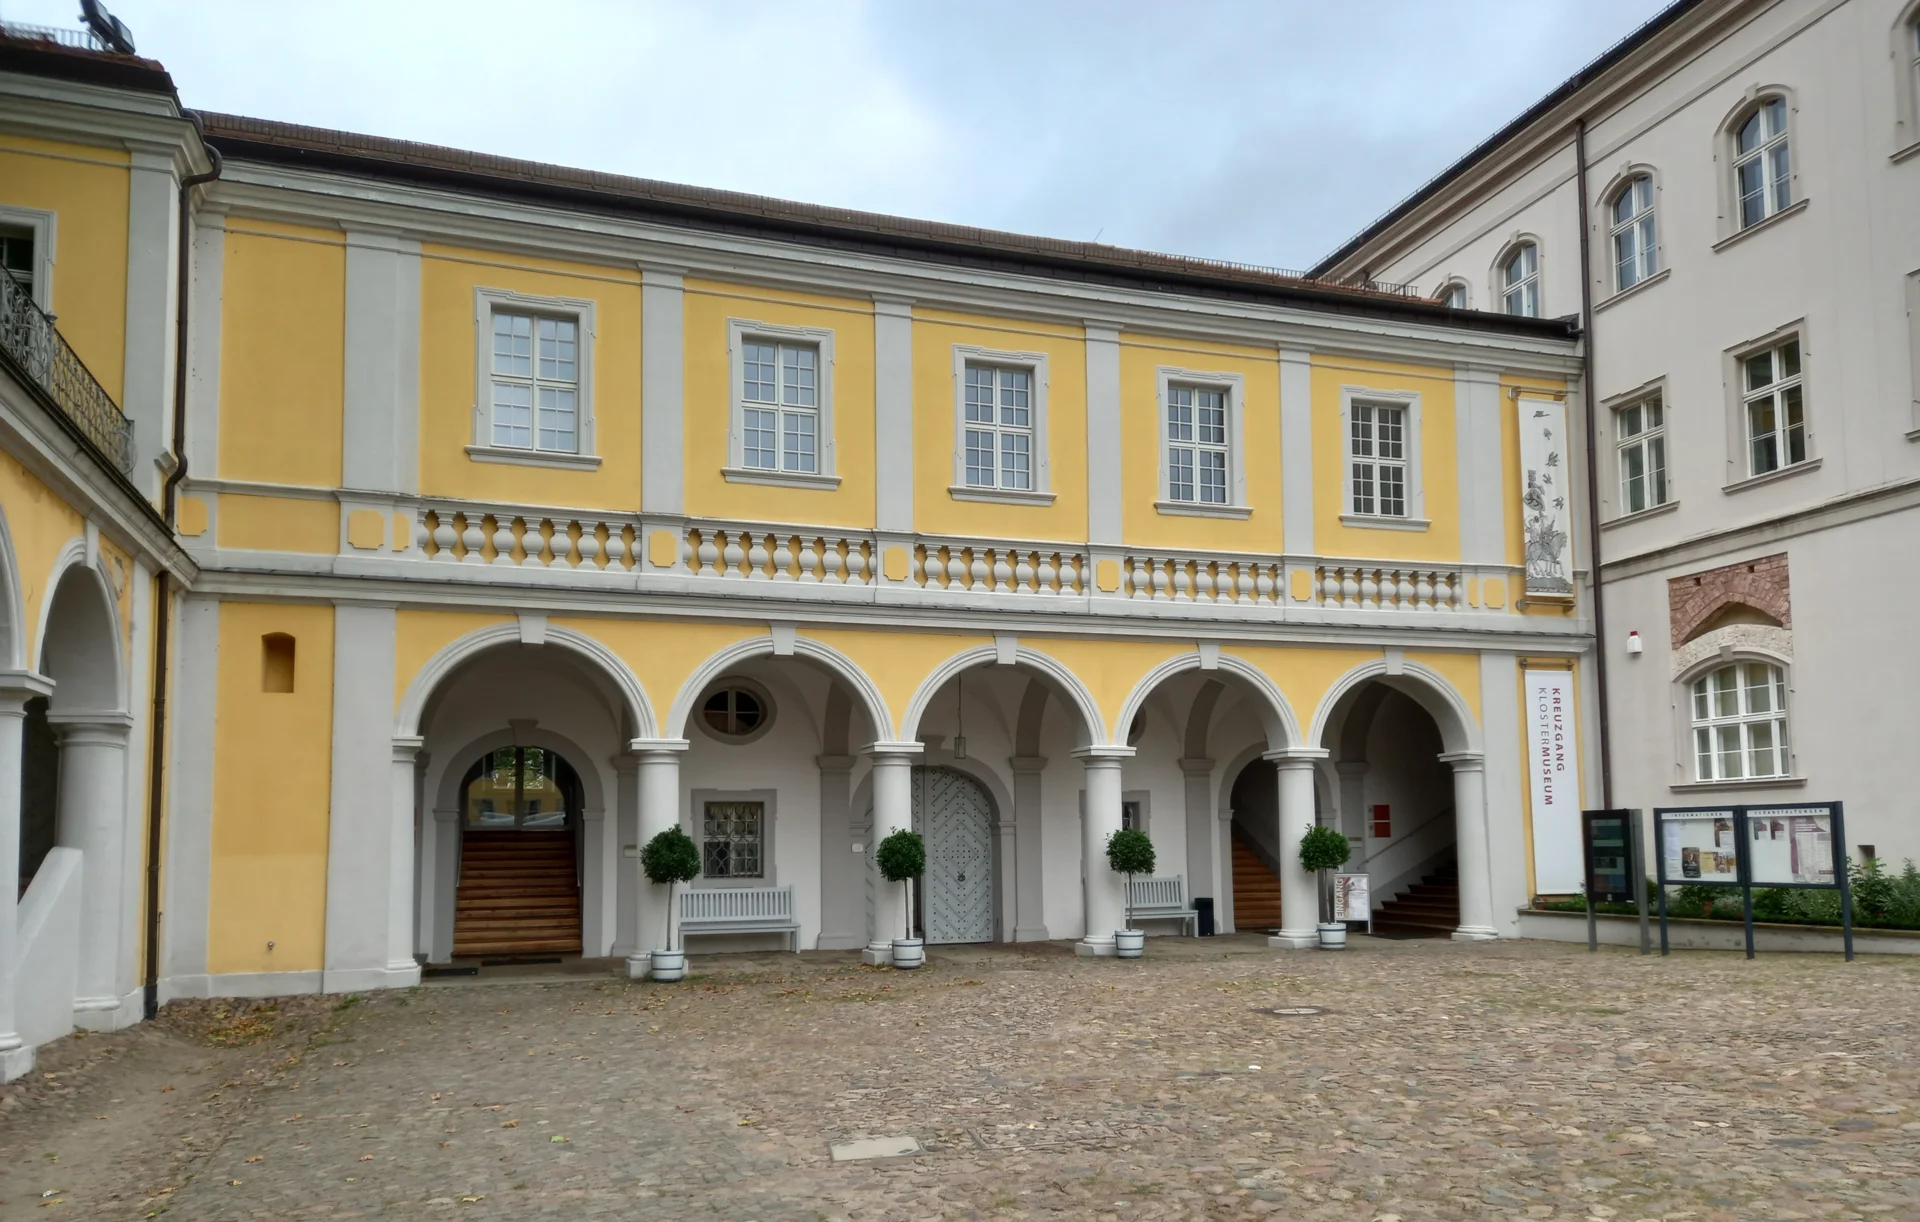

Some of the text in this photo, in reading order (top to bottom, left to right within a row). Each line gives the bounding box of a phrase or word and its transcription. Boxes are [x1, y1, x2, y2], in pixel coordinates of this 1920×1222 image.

[1538, 687, 1553, 805] KLOSTERMUSEUM
[1552, 687, 1565, 772] KREUZGANG
[1335, 878, 1344, 918] EINGANG
